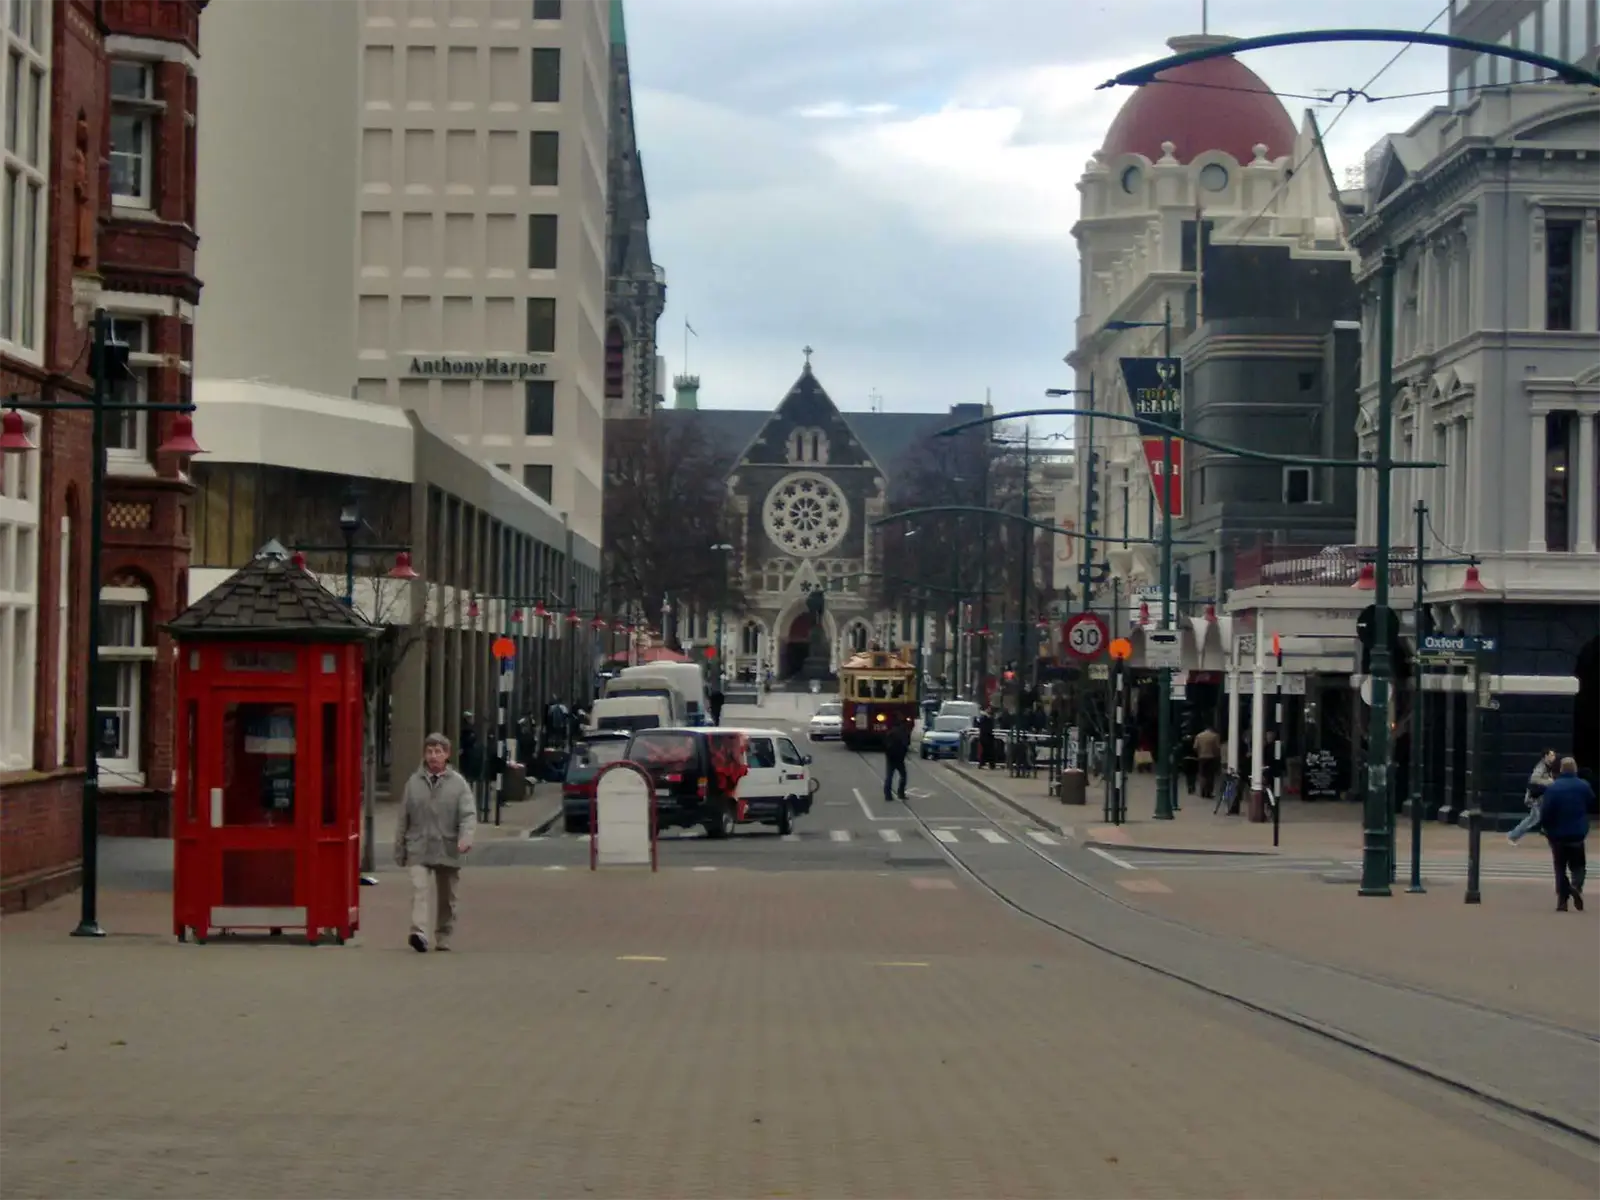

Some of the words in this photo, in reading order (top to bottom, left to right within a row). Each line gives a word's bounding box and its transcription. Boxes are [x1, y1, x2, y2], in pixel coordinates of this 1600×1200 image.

[1151, 460, 1179, 475] Ti
[1073, 628, 1099, 646] 30
[1424, 637, 1464, 649] Oxford
